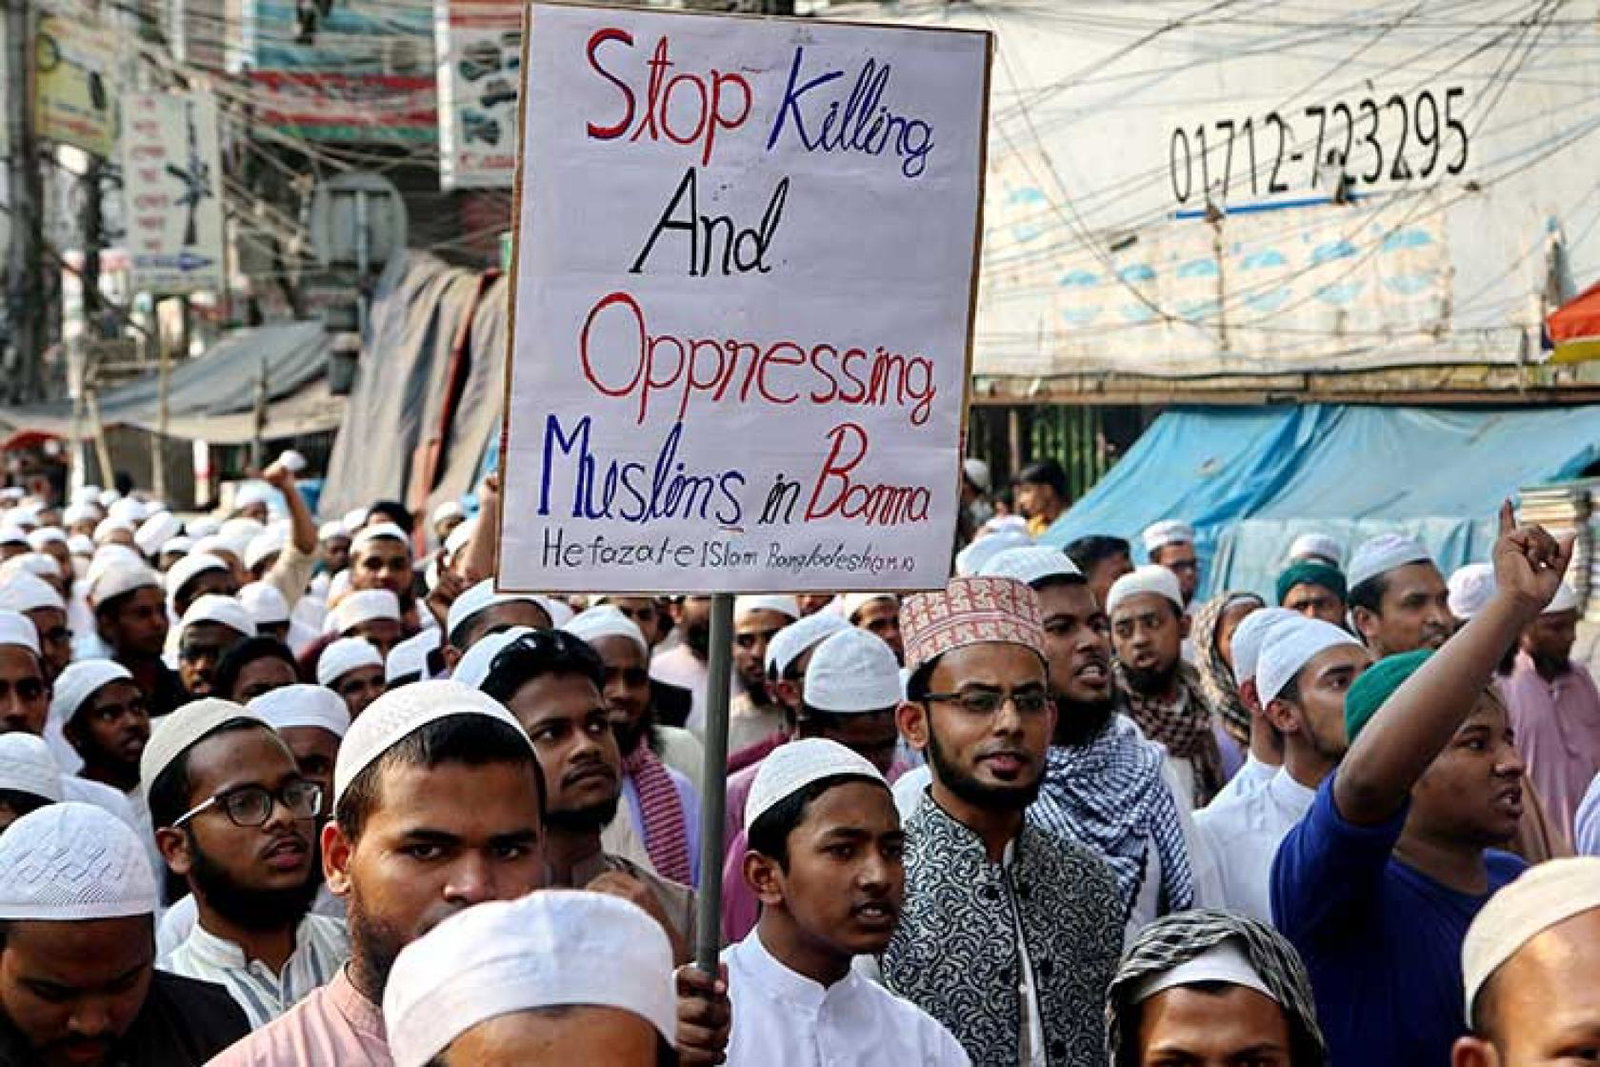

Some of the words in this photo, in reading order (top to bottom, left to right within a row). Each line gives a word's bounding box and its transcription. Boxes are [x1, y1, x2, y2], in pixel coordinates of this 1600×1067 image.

[586, 27, 752, 167] Stop
[767, 46, 934, 178] Killing
[1170, 87, 1468, 204] 01712-723295
[629, 166, 790, 277] And
[580, 291, 936, 425] Oppressing
[537, 414, 746, 525] Muslims
[758, 473, 801, 525] in
